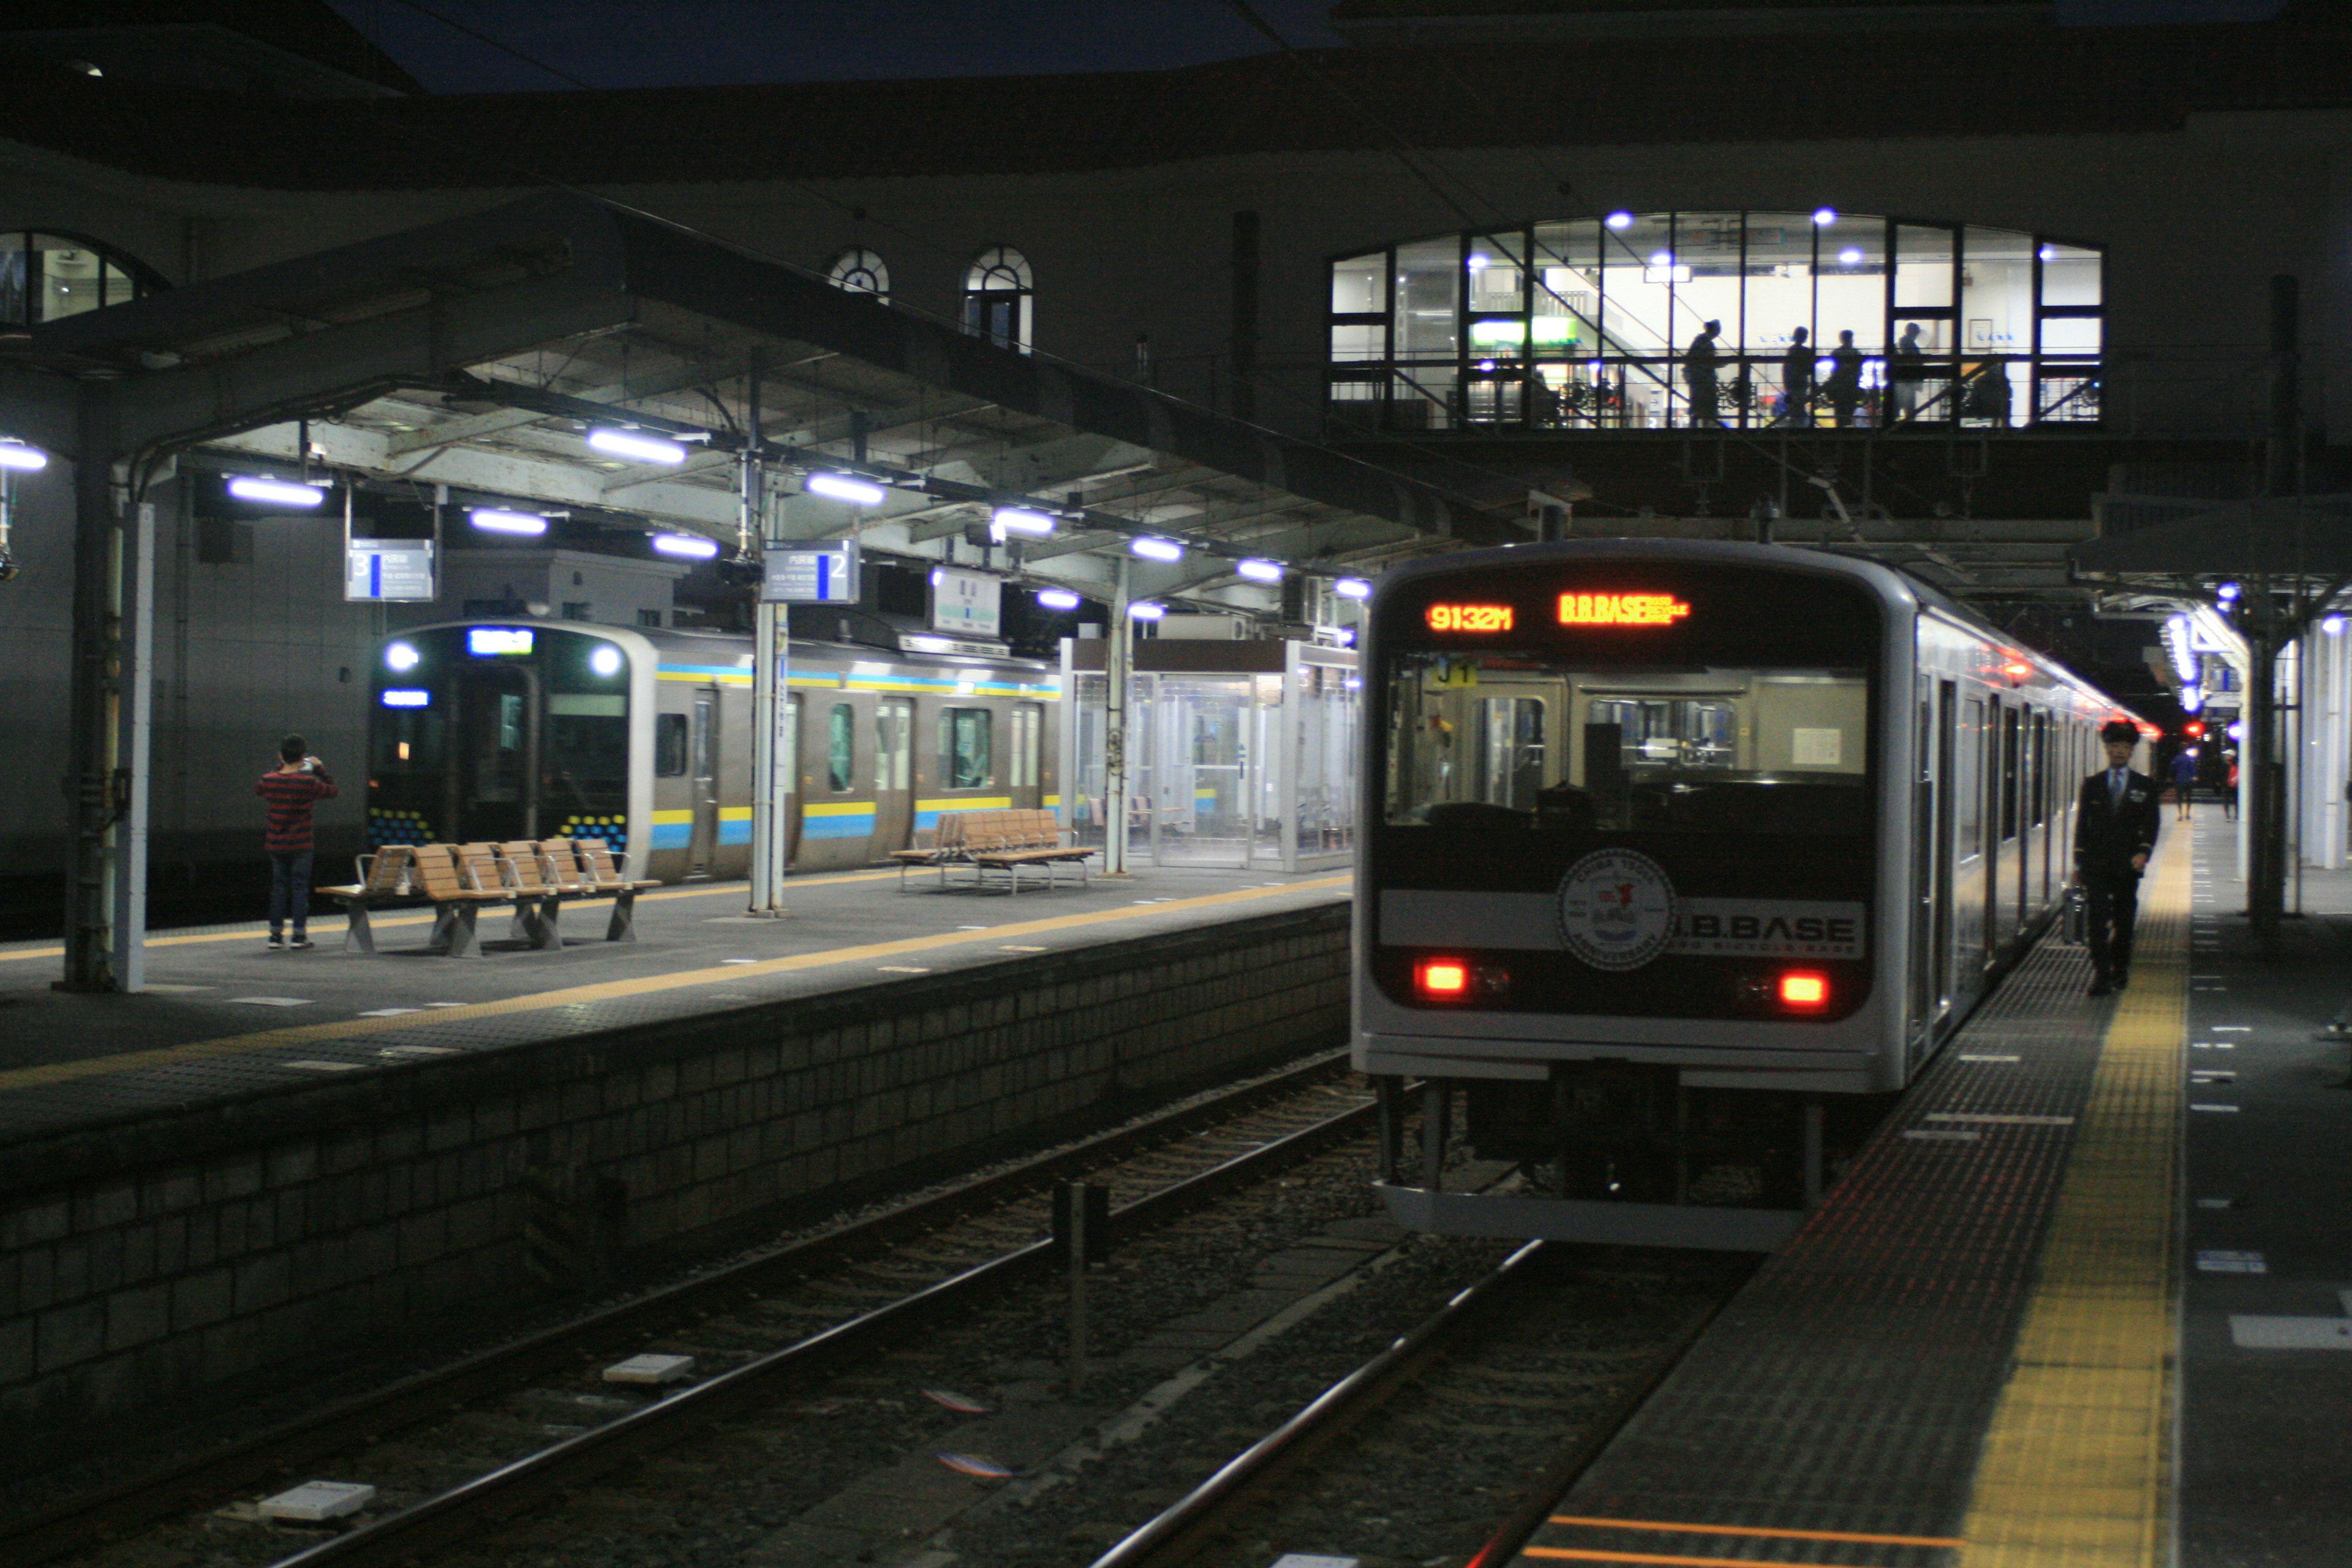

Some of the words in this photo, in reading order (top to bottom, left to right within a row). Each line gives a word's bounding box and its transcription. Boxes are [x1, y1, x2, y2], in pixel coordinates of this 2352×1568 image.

[354, 553, 368, 576] 3
[831, 554, 846, 578] 2
[1431, 606, 1512, 630] 9132M
